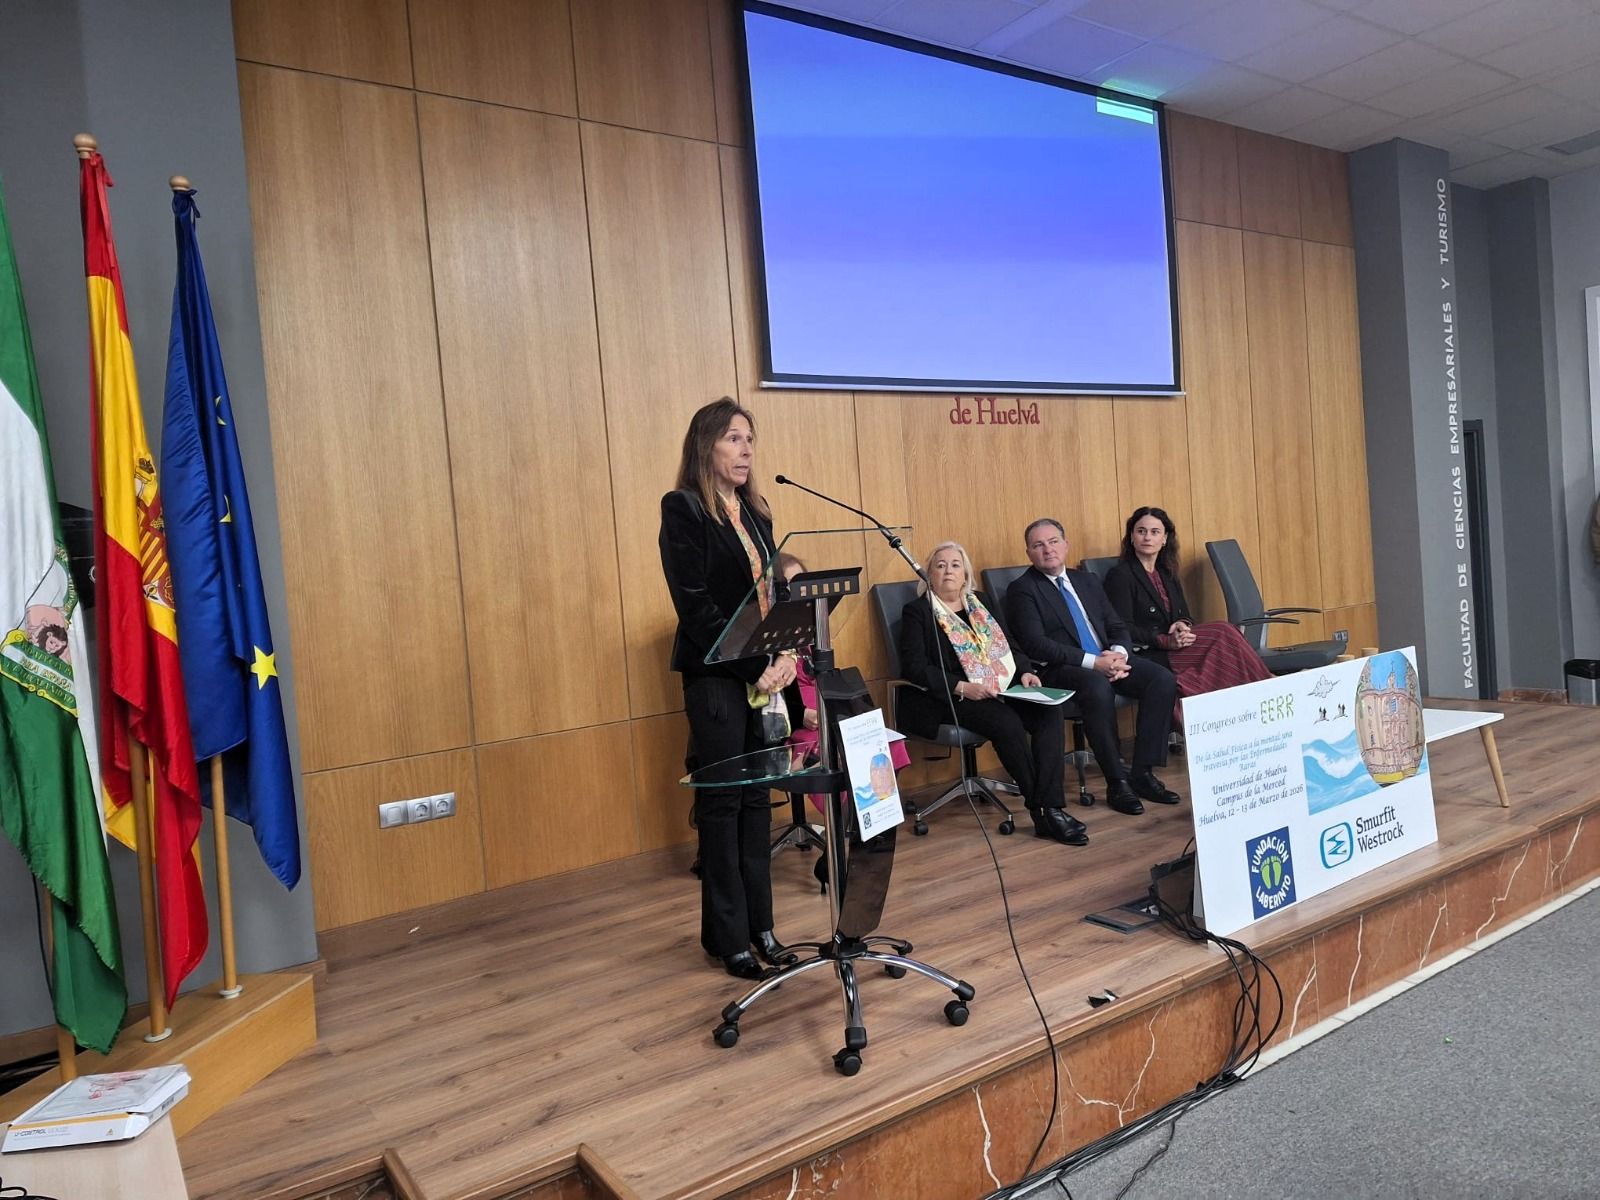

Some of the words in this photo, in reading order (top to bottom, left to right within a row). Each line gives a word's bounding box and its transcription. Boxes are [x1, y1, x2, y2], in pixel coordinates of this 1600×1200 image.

[1437, 178, 1449, 265] TURISMO
[1441, 277, 1451, 291] Y
[1441, 301, 1460, 455] EMPRESARIALES
[949, 396, 973, 425] de
[974, 396, 1040, 425] Huelva
[1451, 466, 1466, 550] CIENCIAS
[1457, 563, 1467, 587] DE
[1460, 598, 1474, 689] FACULTAD
[1189, 724, 1200, 735] III
[1201, 716, 1236, 733] Congreso
[1238, 710, 1257, 721] sobre
[1260, 693, 1294, 724] EERR
[1212, 772, 1254, 795] Universidad
[1255, 769, 1263, 781] de
[1263, 765, 1288, 779] Huelva
[1216, 792, 1243, 807] Campus
[1244, 787, 1253, 798] de
[1254, 784, 1261, 795] la
[1262, 774, 1286, 793] Merced
[1199, 810, 1227, 827] Huelva,
[1228, 807, 1235, 817] 12
[1241, 804, 1248, 813] 13
[1249, 798, 1257, 810] de
[1259, 793, 1279, 807] Marzo
[1280, 787, 1288, 799] de
[1289, 784, 1304, 796] 2026
[1356, 805, 1396, 835] Smurfit
[1251, 835, 1290, 874] FUNDACIÓN
[1357, 821, 1404, 854] Westrock
[1255, 874, 1292, 910] LABERINTO
